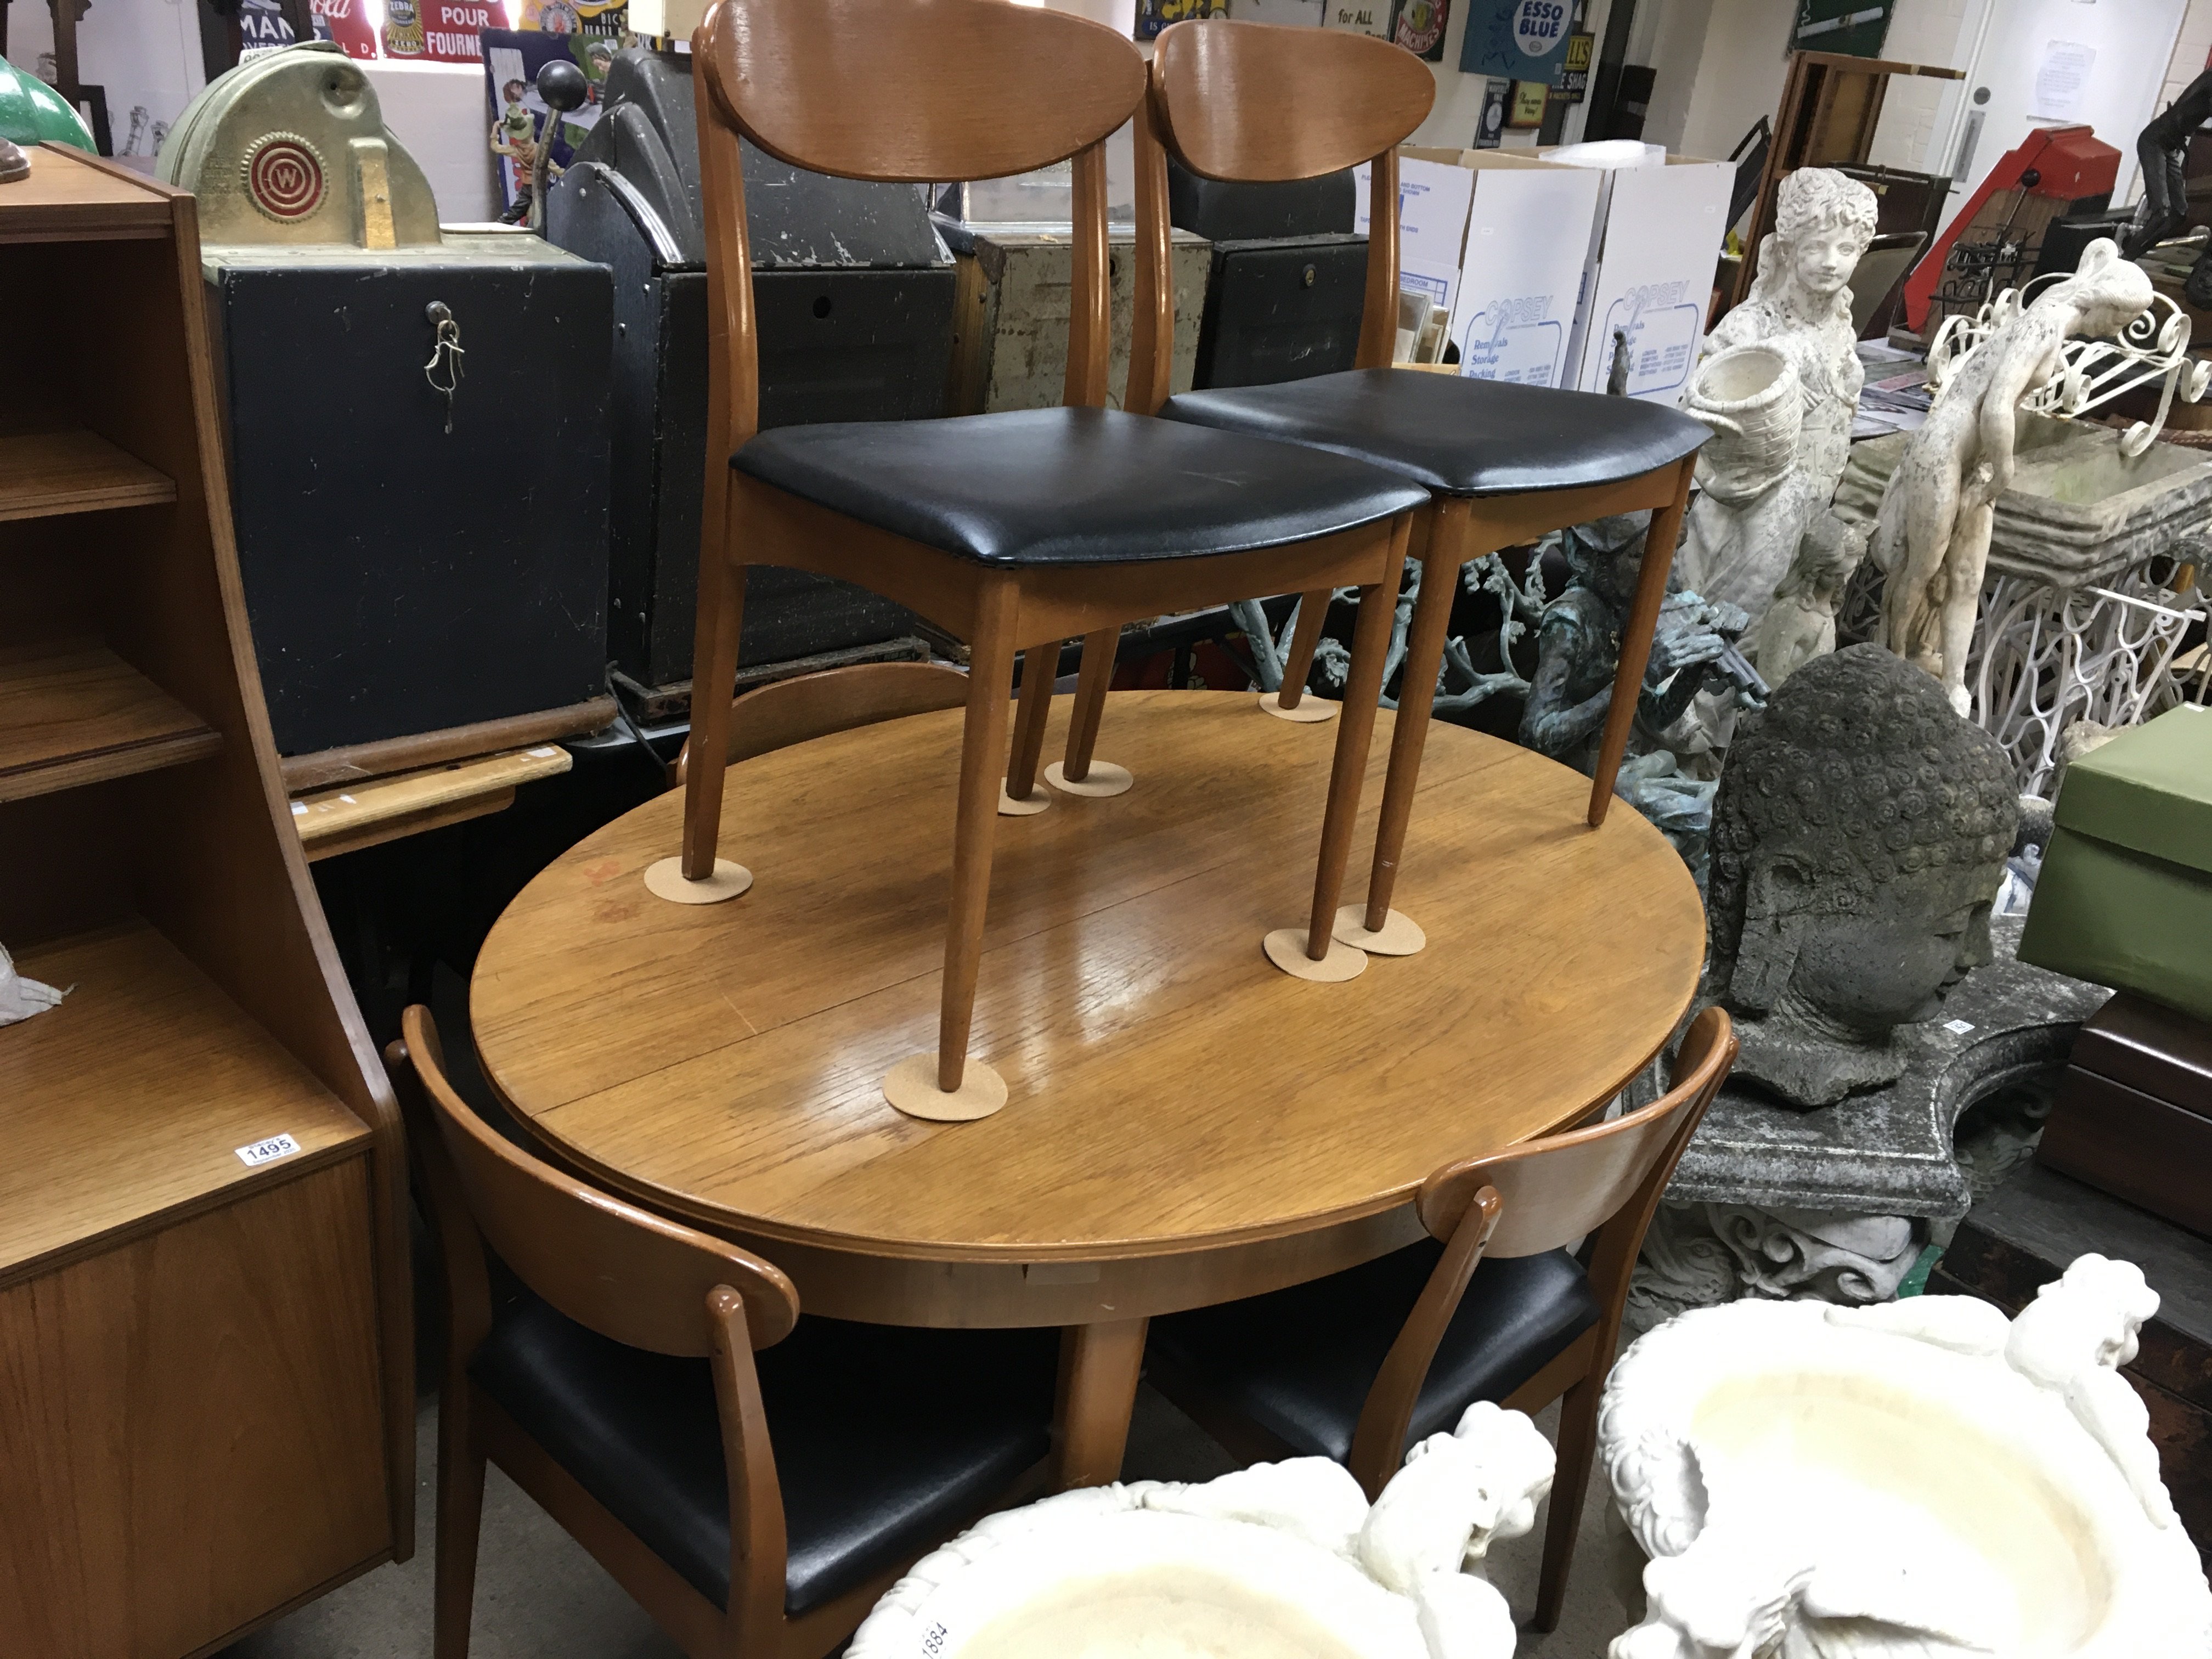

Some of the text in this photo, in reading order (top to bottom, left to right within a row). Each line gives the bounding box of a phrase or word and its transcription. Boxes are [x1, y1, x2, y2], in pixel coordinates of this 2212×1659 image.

[441, 7, 490, 26] POUR
[1338, 9, 1373, 25] for ALL
[1522, 1, 1564, 20] ESSO
[1519, 19, 1560, 38] BLUE
[1567, 72, 1586, 89] SHAG
[275, 168, 297, 189] W
[1410, 183, 1431, 192] BOTTOM
[1623, 280, 1690, 311] COPSEY
[1485, 295, 1554, 326] COPSEY
[1474, 337, 1508, 350] Remvals
[1471, 354, 1499, 365] Storage
[1469, 368, 1496, 379] Packing
[247, 1139, 291, 1159] 1495
[922, 1622, 948, 1659] 1884
